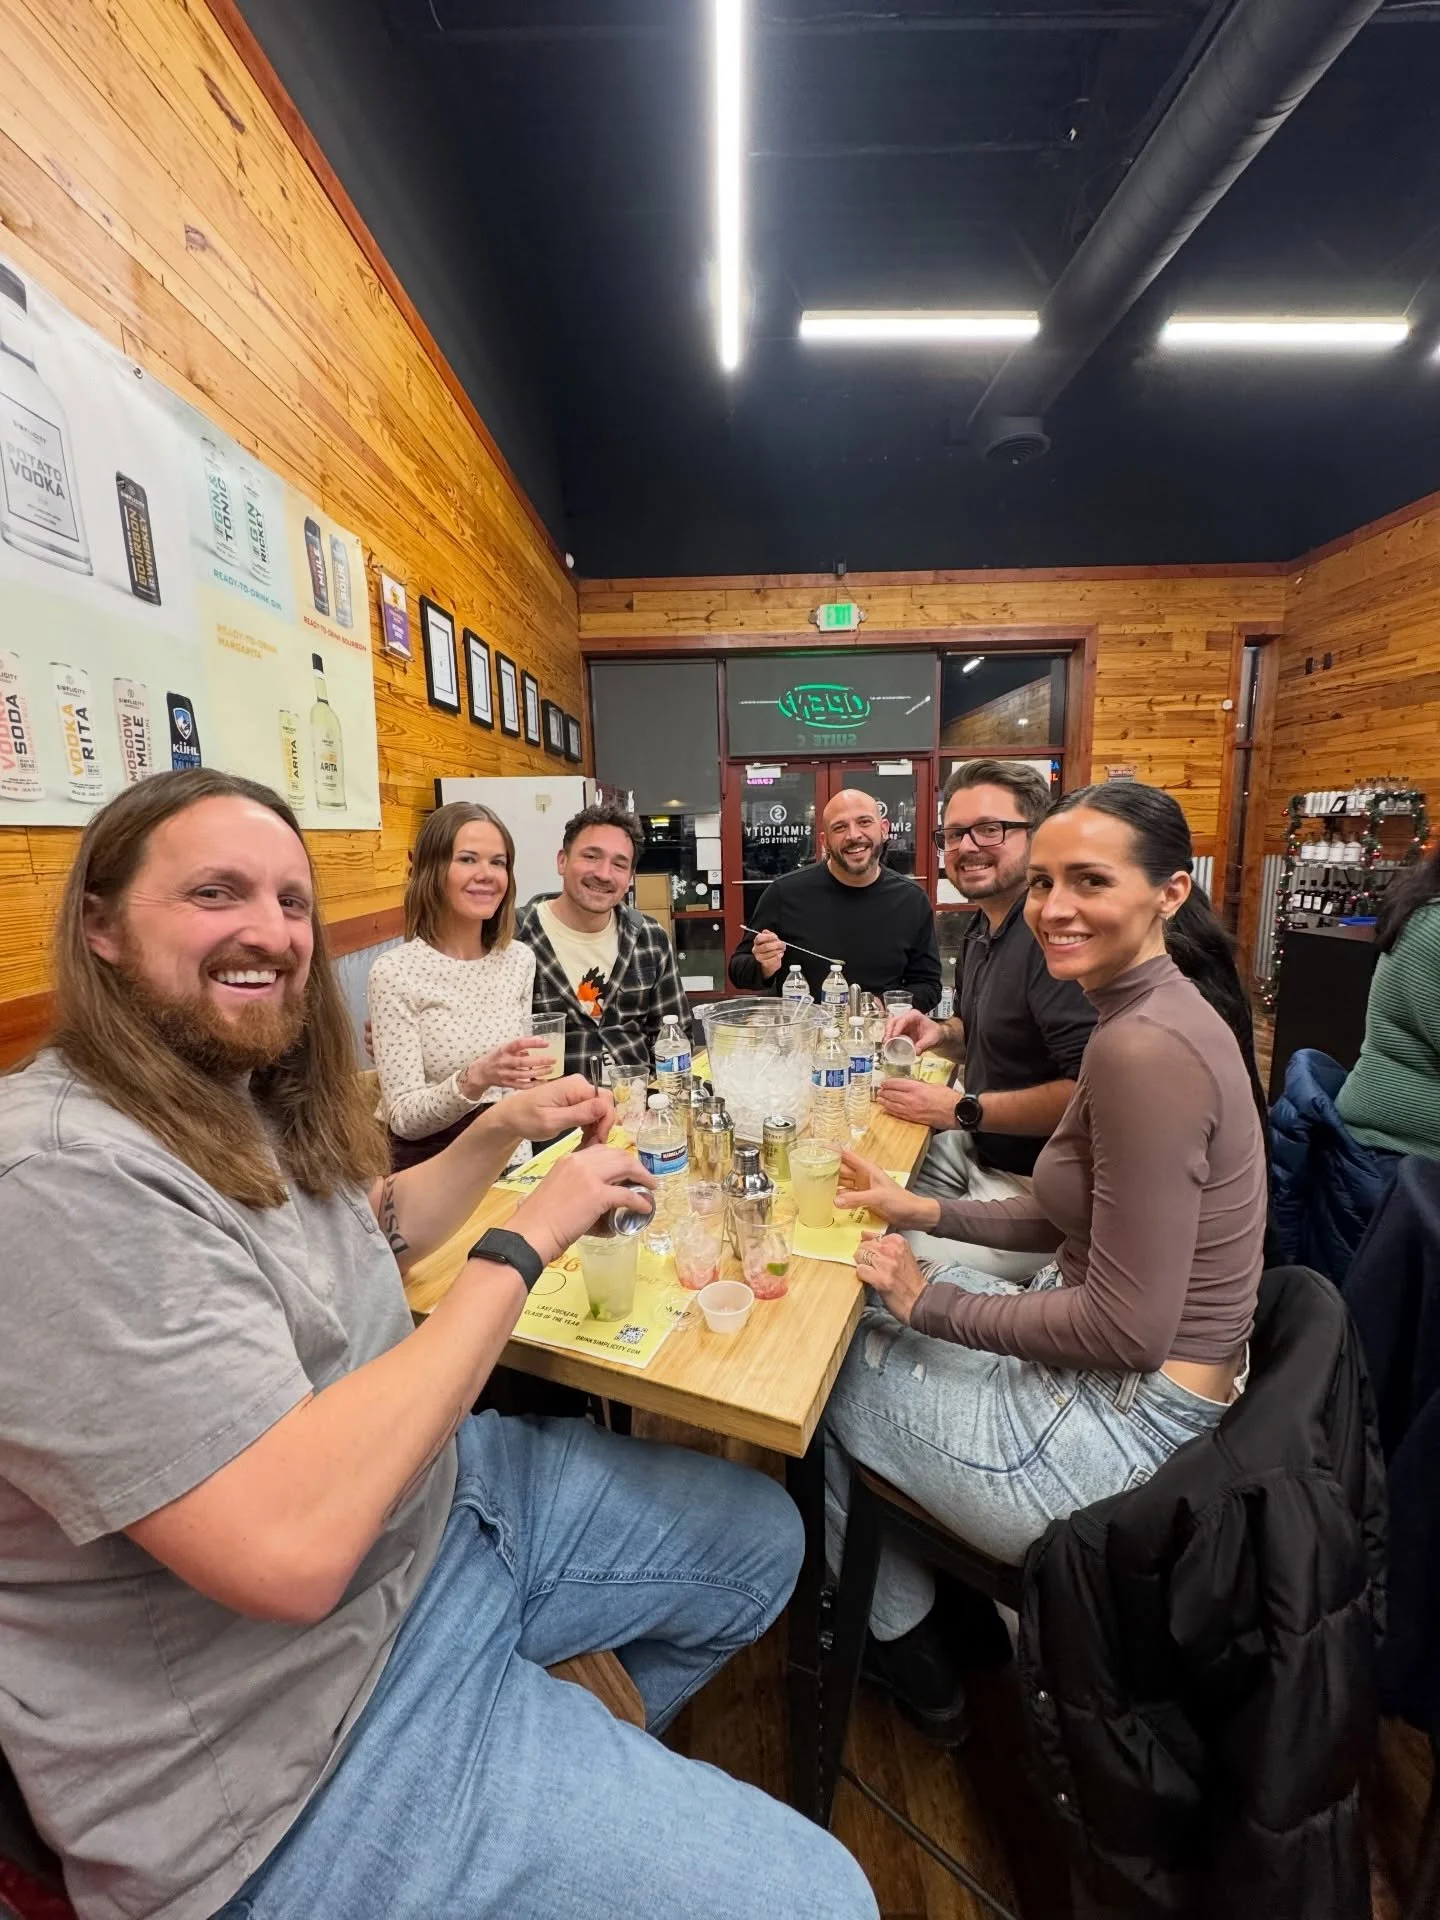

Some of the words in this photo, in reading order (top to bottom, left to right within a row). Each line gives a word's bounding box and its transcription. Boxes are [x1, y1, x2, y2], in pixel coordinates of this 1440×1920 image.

[6, 441, 62, 482] POTATO
[9, 455, 65, 500] VODKA
[210, 491, 222, 523] GIN
[218, 477, 233, 542] TONIC
[247, 501, 259, 541] GIN
[128, 508, 148, 586] BOURBON
[138, 516, 154, 578] WHISKEY
[255, 508, 267, 563] RICKEY
[313, 548, 325, 586] MULE
[5, 694, 27, 755] SODA
[62, 703, 84, 776] VODKA
[75, 707, 95, 760] RITA
[132, 715, 148, 767] MULE
[121, 714, 139, 782] MOSCOW
[173, 742, 200, 756] KÜHL
[290, 740, 300, 779] ARITA
[320, 762, 338, 773] ARITA
[524, 1309, 543, 1318] CLASS
[564, 1319, 580, 1327] YEAR
[552, 1308, 579, 1319] COCKTAIL
